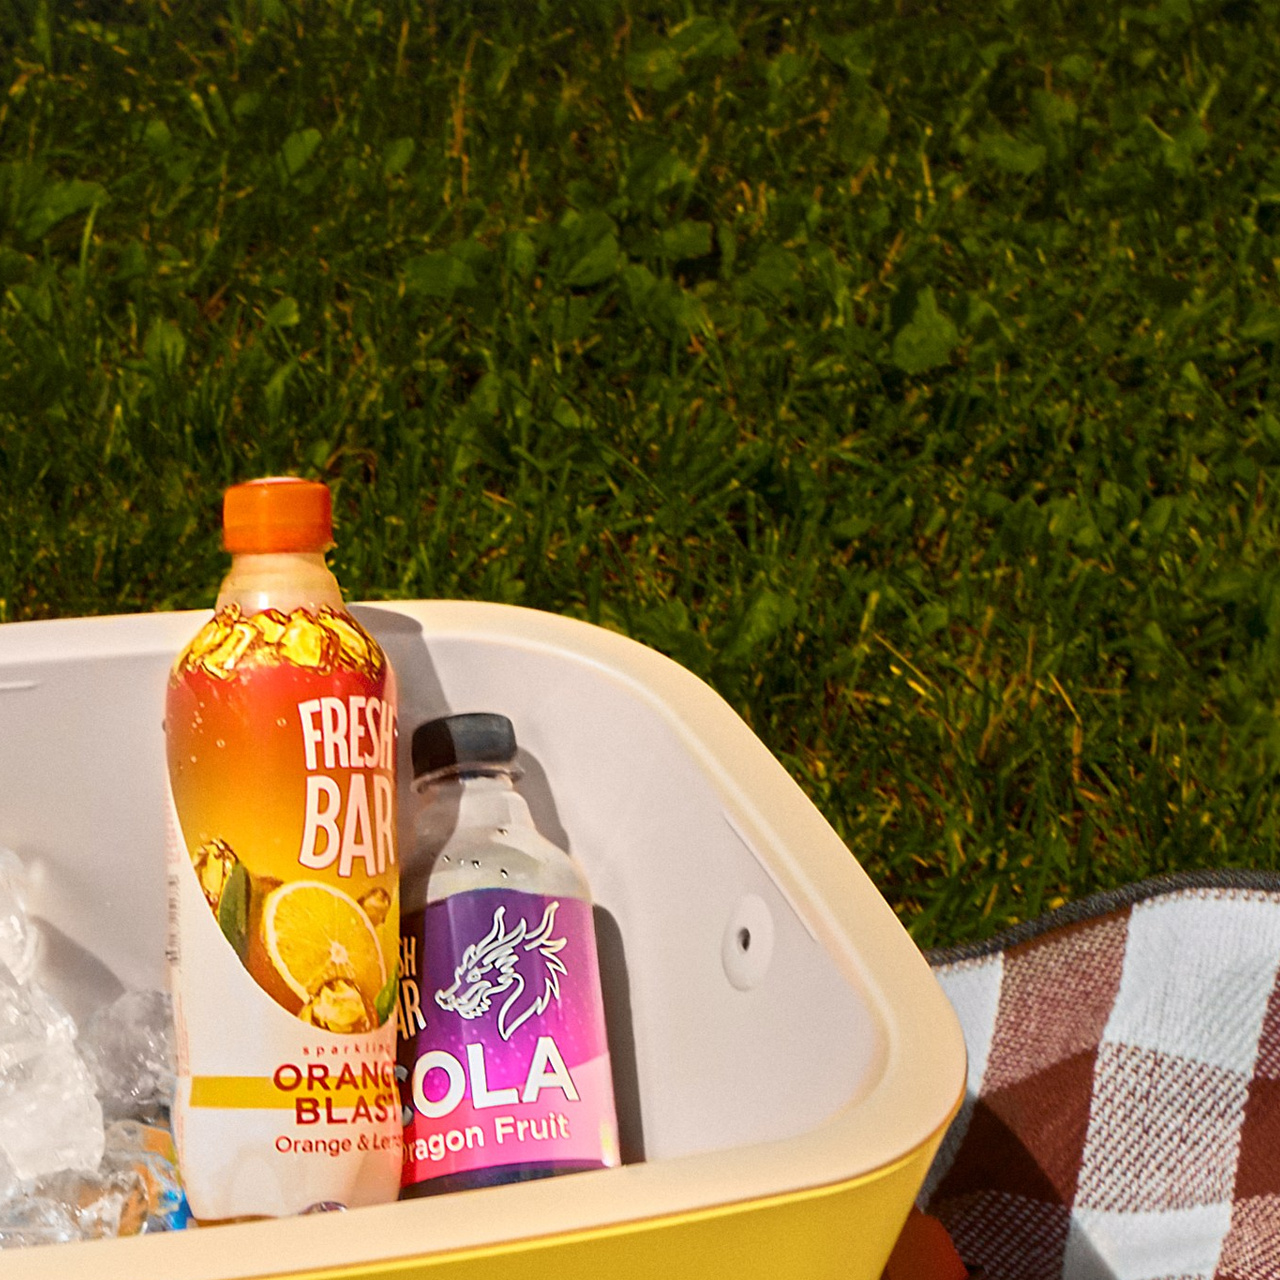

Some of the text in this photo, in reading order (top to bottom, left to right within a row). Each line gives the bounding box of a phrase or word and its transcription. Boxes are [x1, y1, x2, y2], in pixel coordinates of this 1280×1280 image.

[298, 696, 393, 770] FRESH
[299, 773, 395, 877] BAR
[295, 1095, 397, 1125] BLAST
[494, 1112, 571, 1144] Fruit
[275, 1135, 352, 1157] Orange
[357, 1134, 369, 1151] &
